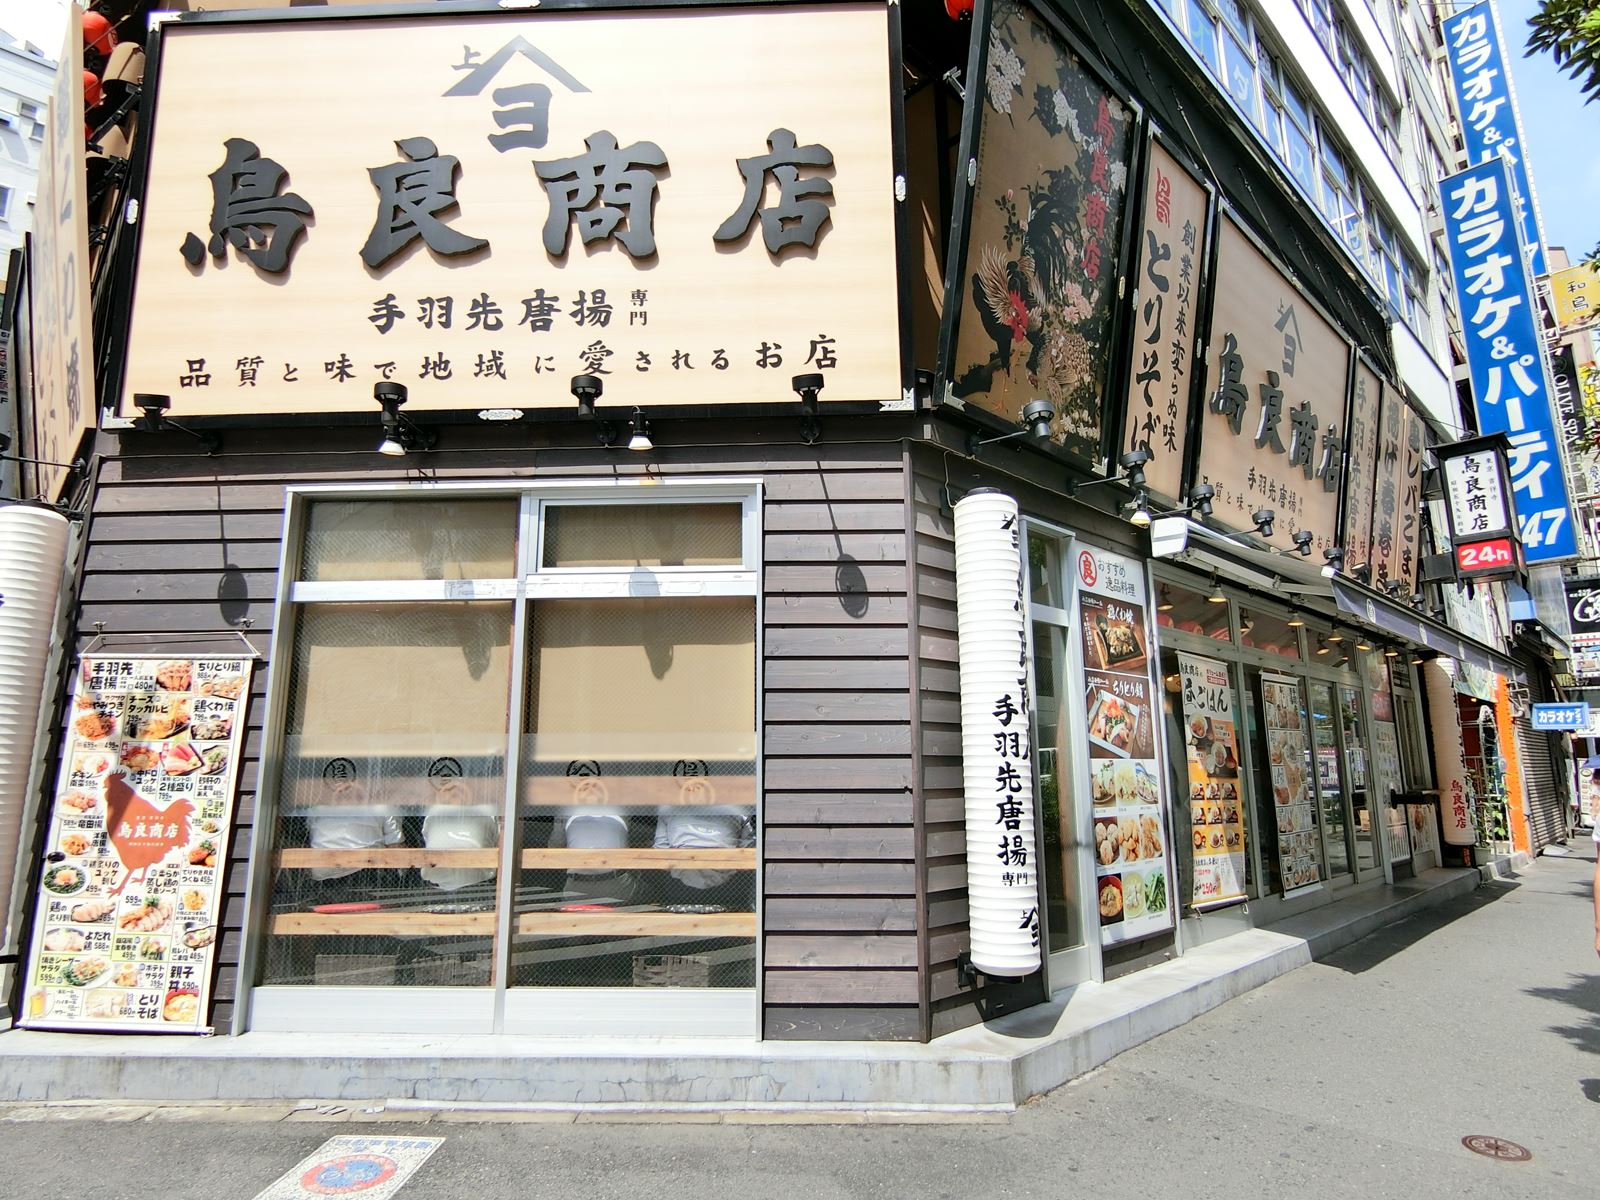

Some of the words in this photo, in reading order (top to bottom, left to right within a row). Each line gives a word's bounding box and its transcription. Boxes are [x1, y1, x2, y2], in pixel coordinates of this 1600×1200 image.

[1082, 95, 1116, 281] 鳥良商店
[179, 126, 838, 277] 鳥良商店
[368, 288, 615, 335] 手羽先唐揚
[628, 288, 649, 327] 専門
[1131, 228, 1172, 462] とりそば
[179, 333, 839, 389] 品質と味で地域に愛されるお店
[1450, 176, 1551, 498] カラオケ&パーティ
[1519, 507, 1566, 548] 47
[1554, 373, 1575, 416] OLIVE
[1209, 331, 1341, 493] 鳥良商店
[1247, 466, 1297, 513] 手羽先唐揚
[1461, 456, 1489, 531] 鳥良商店
[1098, 559, 1126, 578] おすすめ
[1105, 576, 1137, 598] 逸品料理
[93, 661, 133, 675] 手羽先
[198, 661, 241, 672] ちりとり鍋
[89, 675, 118, 690] 唐揚
[129, 695, 154, 703] チーズ
[1184, 677, 1228, 713] 昼ごはん
[92, 701, 125, 710] やみつき
[128, 704, 168, 713] タッカルビ
[193, 699, 234, 712] 鶏くわ焼
[1538, 710, 1575, 724] カラオケ
[137, 769, 157, 777] 中トロ
[992, 693, 1028, 869] 手羽先唐揚
[159, 782, 193, 792] 2種盛り
[1451, 779, 1468, 829] 鳥良商店
[117, 821, 179, 838] 鳥良商店
[1001, 872, 1029, 886] 専門
[85, 931, 111, 940] よだれ
[145, 964, 164, 972] ポテト
[170, 965, 194, 979] 親子
[138, 994, 160, 1006] とり
[137, 1007, 160, 1019] そば
